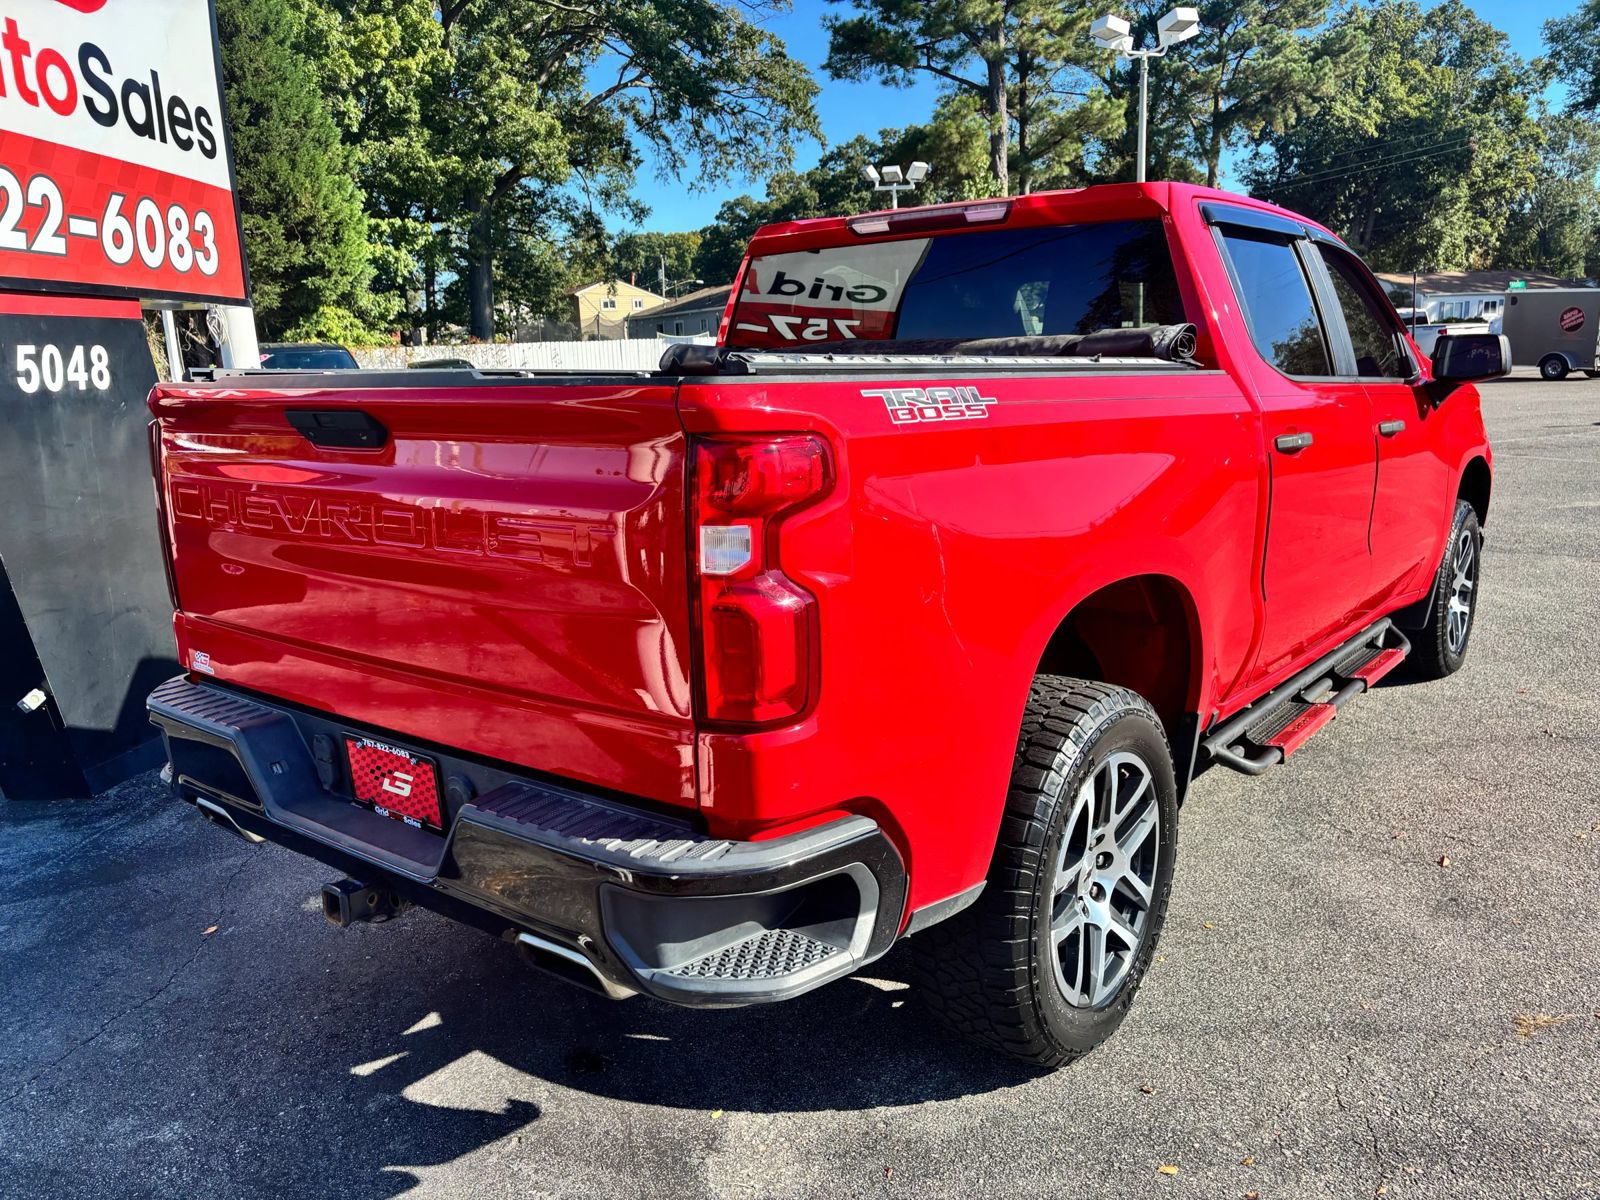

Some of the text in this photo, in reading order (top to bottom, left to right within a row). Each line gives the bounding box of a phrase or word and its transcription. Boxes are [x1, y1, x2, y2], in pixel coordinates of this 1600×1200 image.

[0, 17, 217, 160] toSales
[16, 344, 110, 394] 5048
[860, 386, 998, 408] TRAIL
[888, 403, 989, 424] BOSS
[173, 482, 617, 568] CHEVROLET
[362, 739, 410, 758] 757-822-6083
